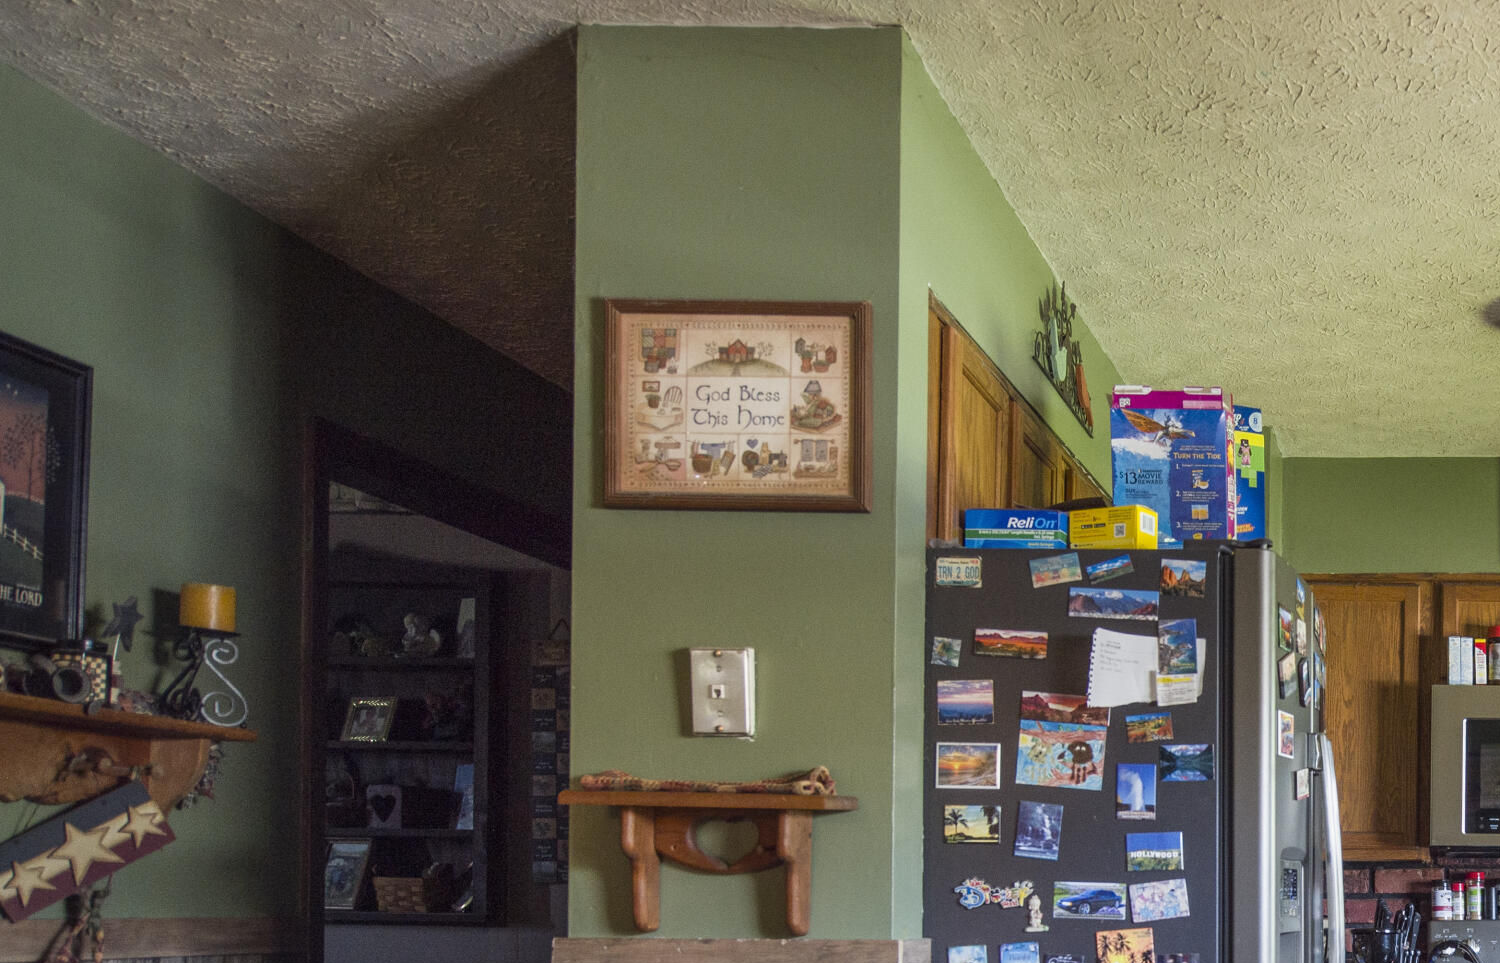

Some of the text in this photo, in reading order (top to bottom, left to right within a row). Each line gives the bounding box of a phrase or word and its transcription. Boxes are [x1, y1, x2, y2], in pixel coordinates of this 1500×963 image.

[695, 384, 781, 405] God Bless
[690, 404, 785, 428] This Home
[938, 565, 953, 578] TRN
[956, 566, 961, 578] 2
[15, 588, 43, 606] LORD
[1130, 850, 1179, 858] HOLLYWOOD
